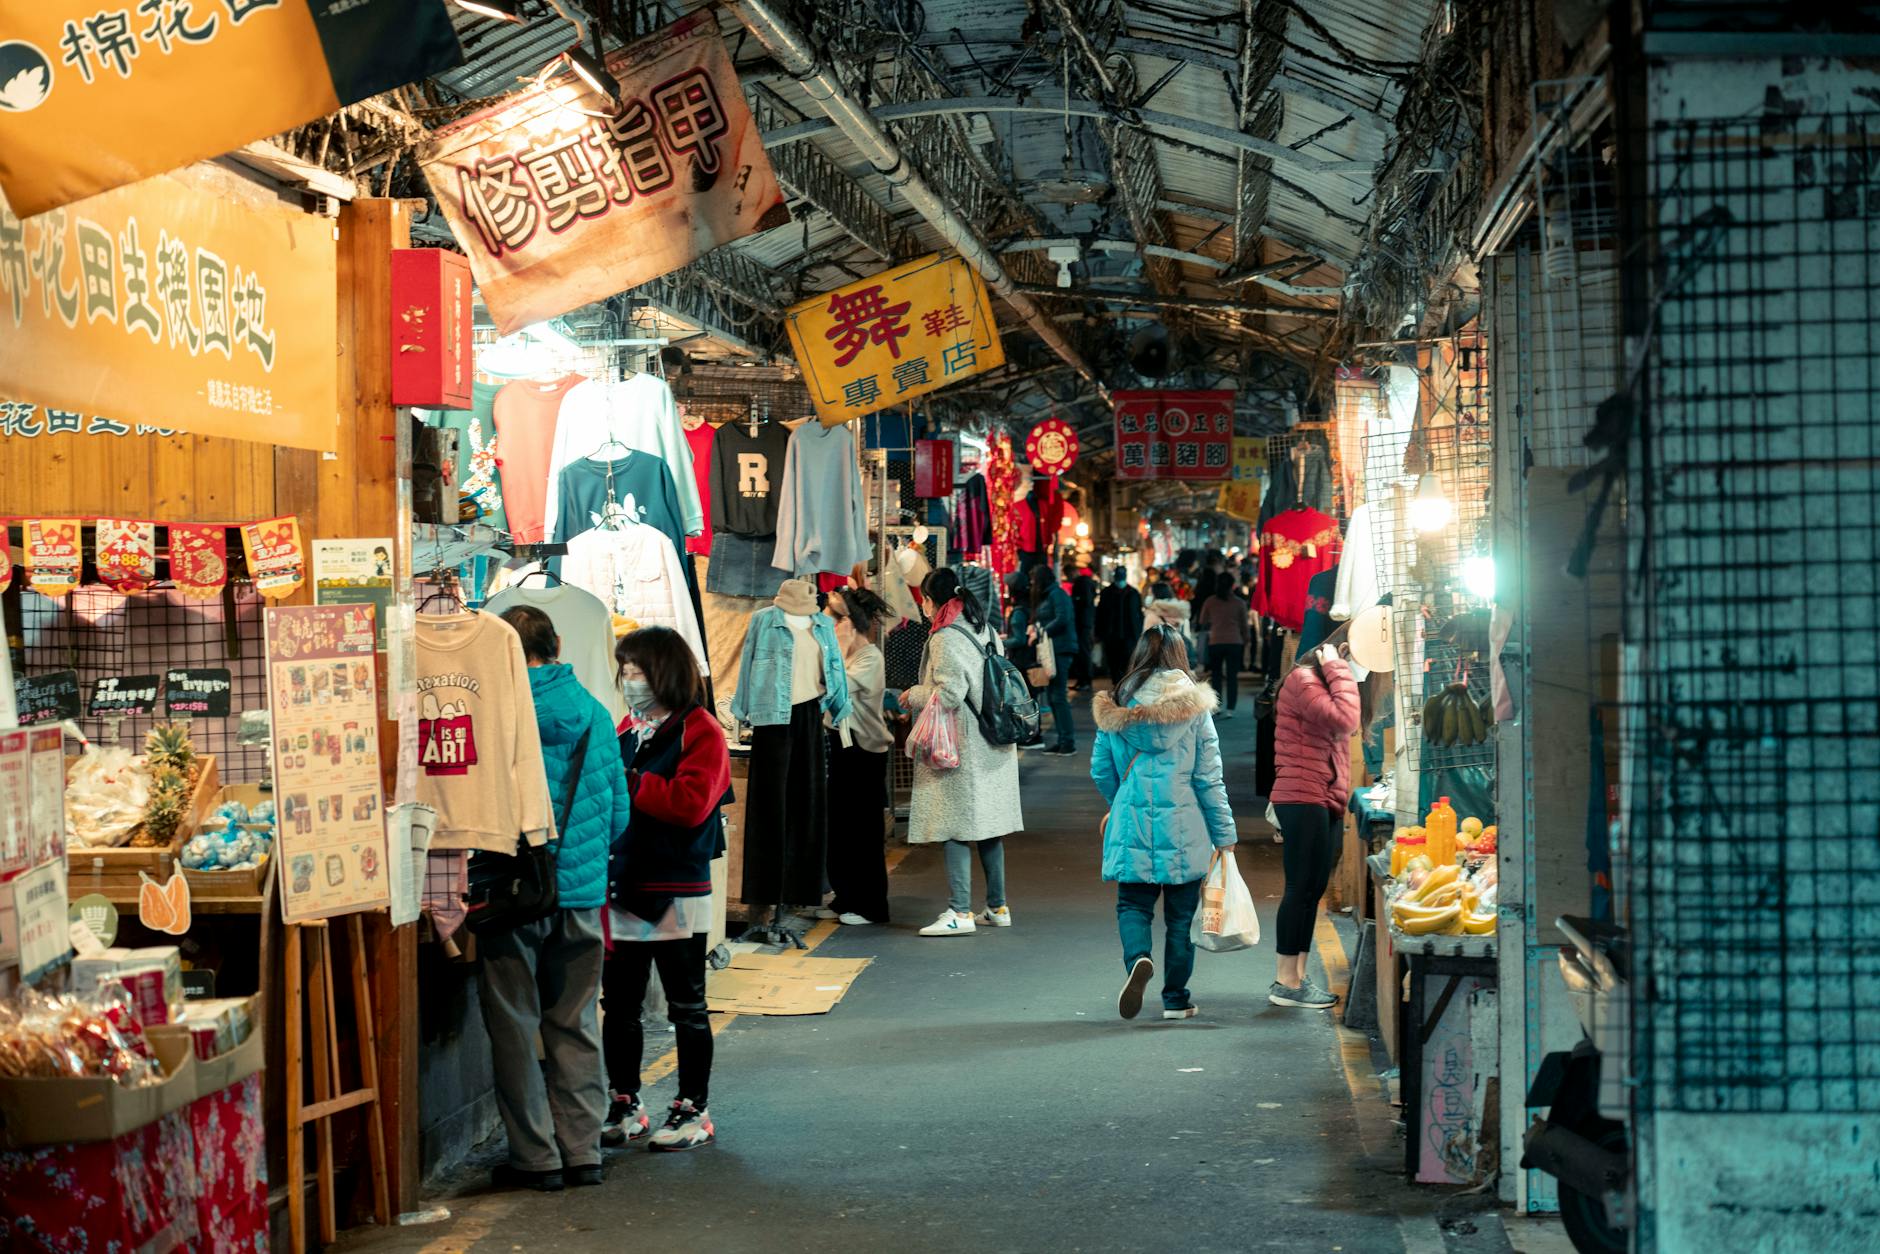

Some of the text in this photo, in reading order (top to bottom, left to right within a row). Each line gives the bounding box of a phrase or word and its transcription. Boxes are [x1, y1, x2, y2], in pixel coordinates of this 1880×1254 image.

[457, 66, 729, 258] 修剪指甲
[824, 284, 972, 368] 舞鞋
[841, 339, 977, 408] 專賣店
[737, 453, 769, 492] R
[417, 673, 479, 693] laxation
[422, 738, 467, 763] ART
[441, 726, 452, 740] is
